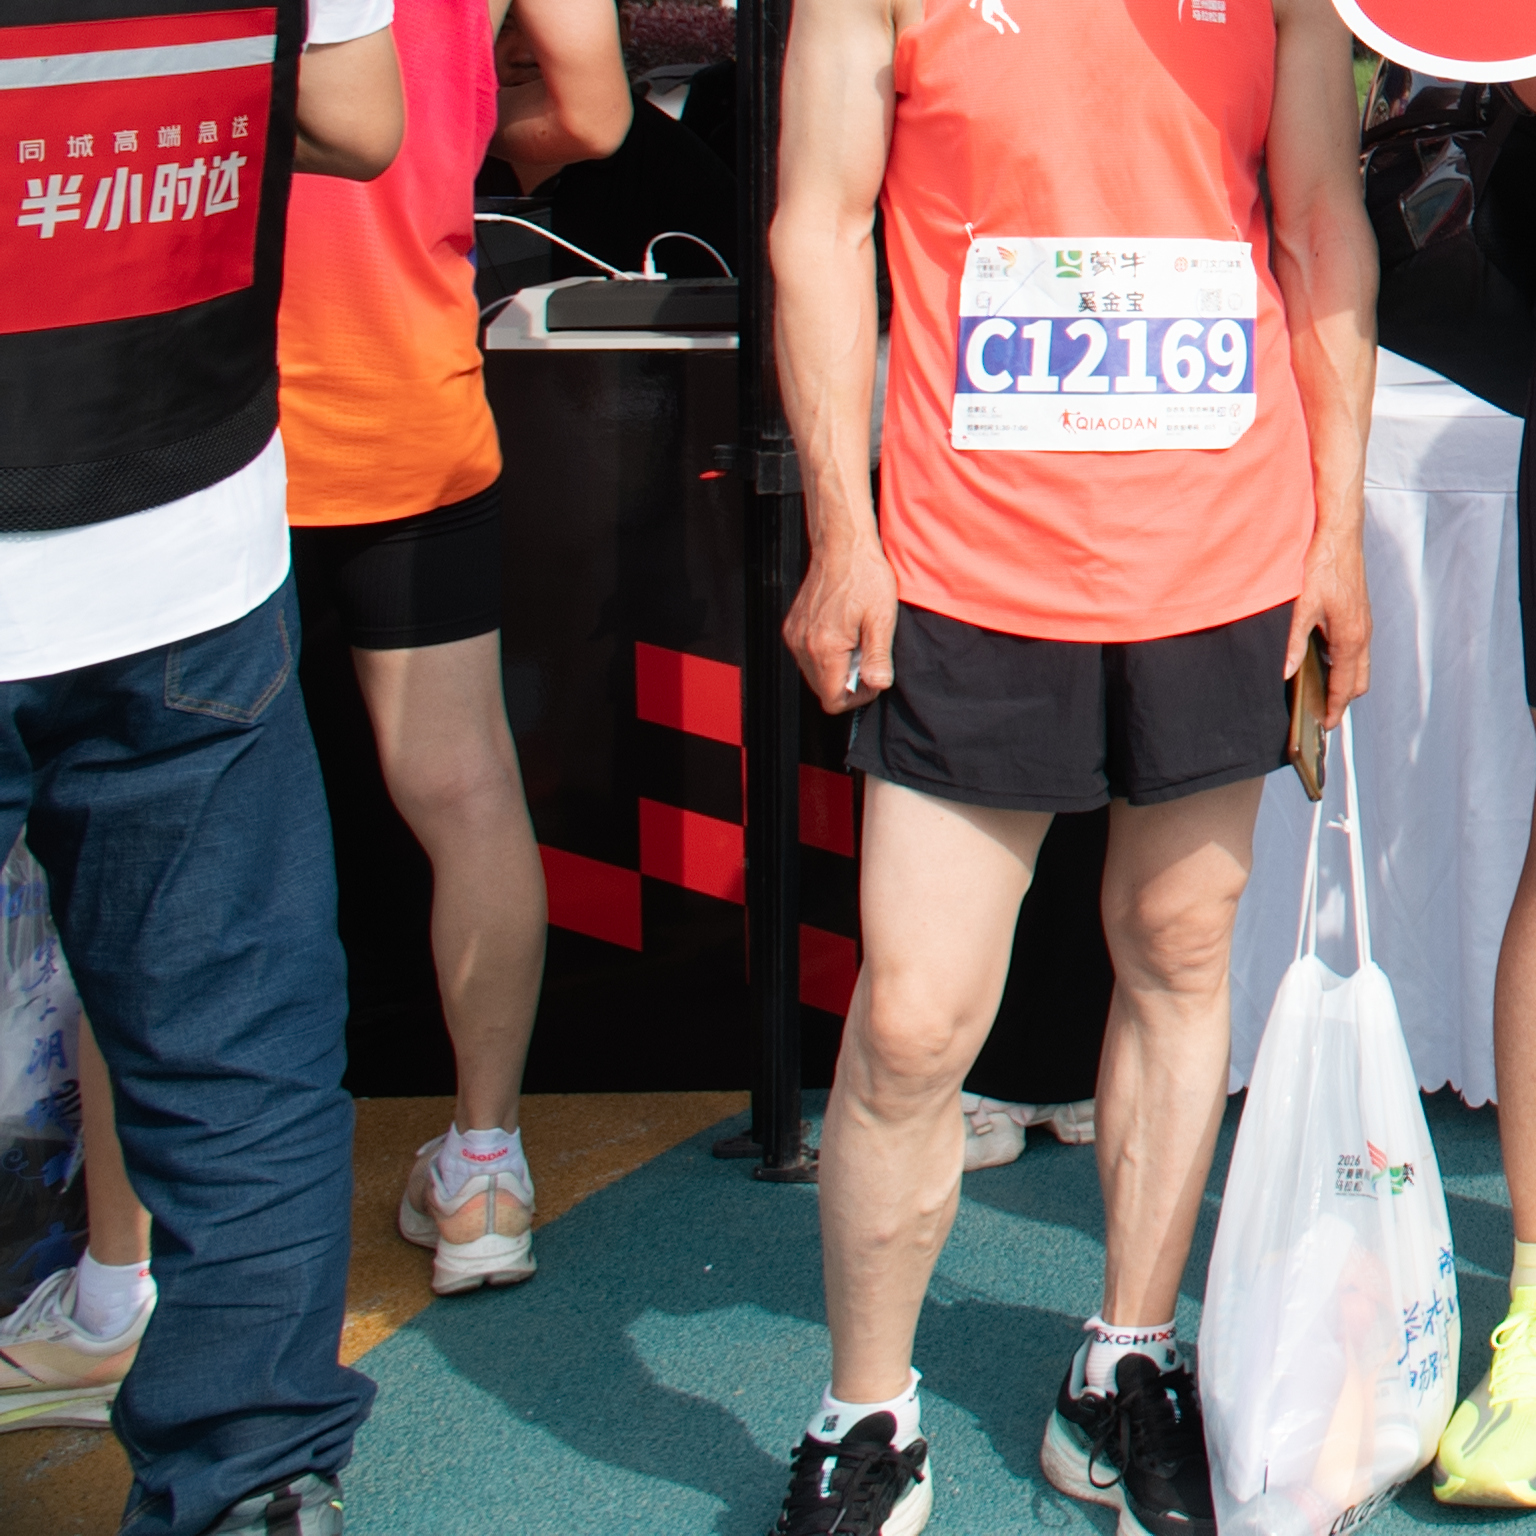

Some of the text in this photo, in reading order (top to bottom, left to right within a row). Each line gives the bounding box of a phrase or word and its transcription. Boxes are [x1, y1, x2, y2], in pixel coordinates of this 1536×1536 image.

[18, 114, 249, 164] 同城高端急送
[17, 150, 248, 240] 半小时达
[1089, 250, 1146, 278] 蒙牛
[965, 317, 1248, 394] C12169
[1076, 416, 1158, 432] QIAODAN
